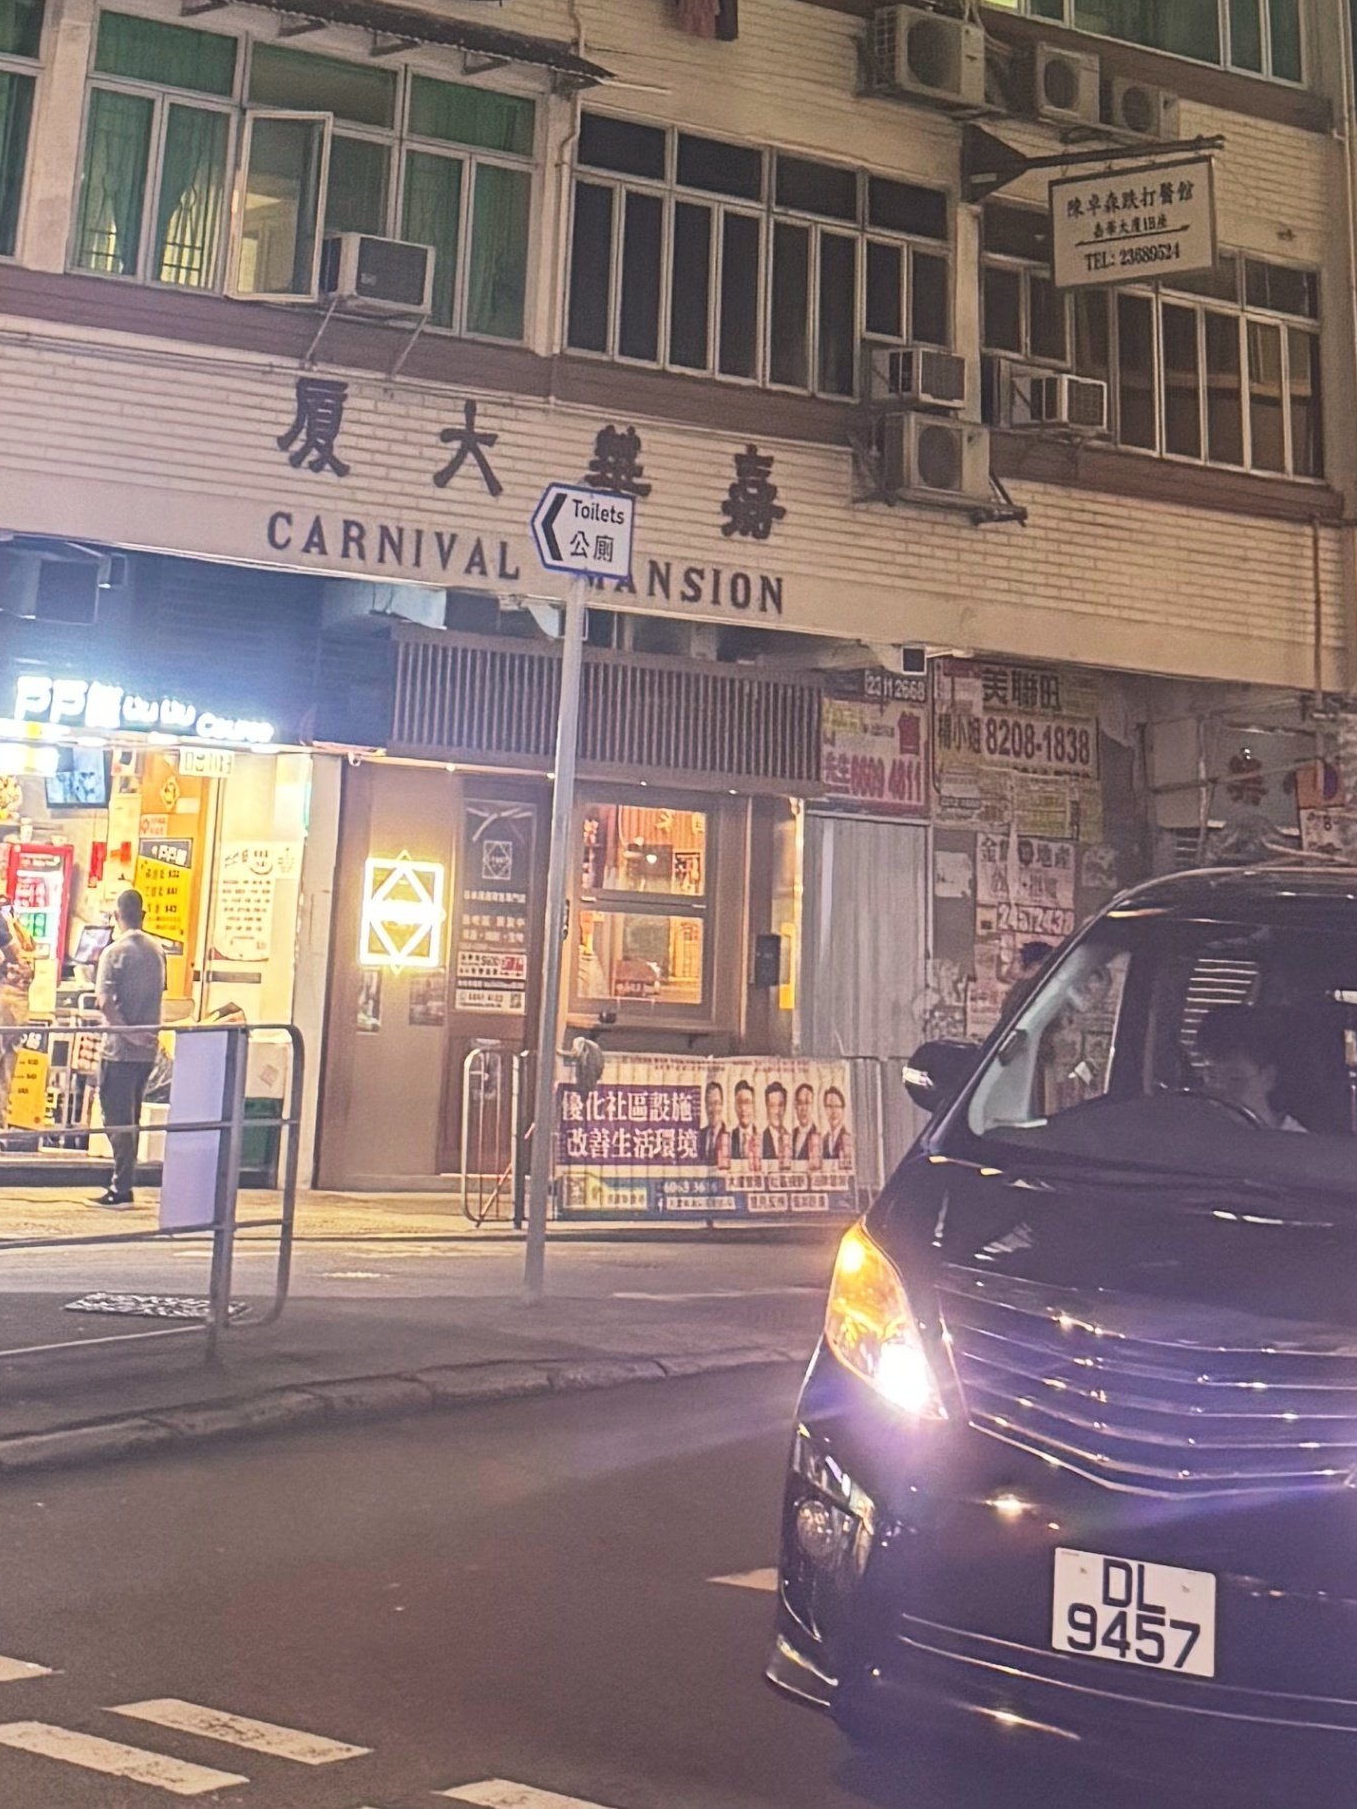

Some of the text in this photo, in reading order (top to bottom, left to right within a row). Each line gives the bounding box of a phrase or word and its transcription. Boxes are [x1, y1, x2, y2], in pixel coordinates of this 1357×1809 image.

[1084, 250, 1115, 271] TEL:
[572, 497, 626, 527] Toilets
[267, 511, 785, 616] CARNIVAL ANSION
[568, 530, 615, 564] 公廁
[985, 716, 1091, 766] 8208-1838
[561, 1090, 694, 1123] 優化社區設施
[566, 1127, 699, 1160] 改善生活環境
[1102, 1557, 1167, 1616] DL
[1067, 1601, 1201, 1669] 9457
